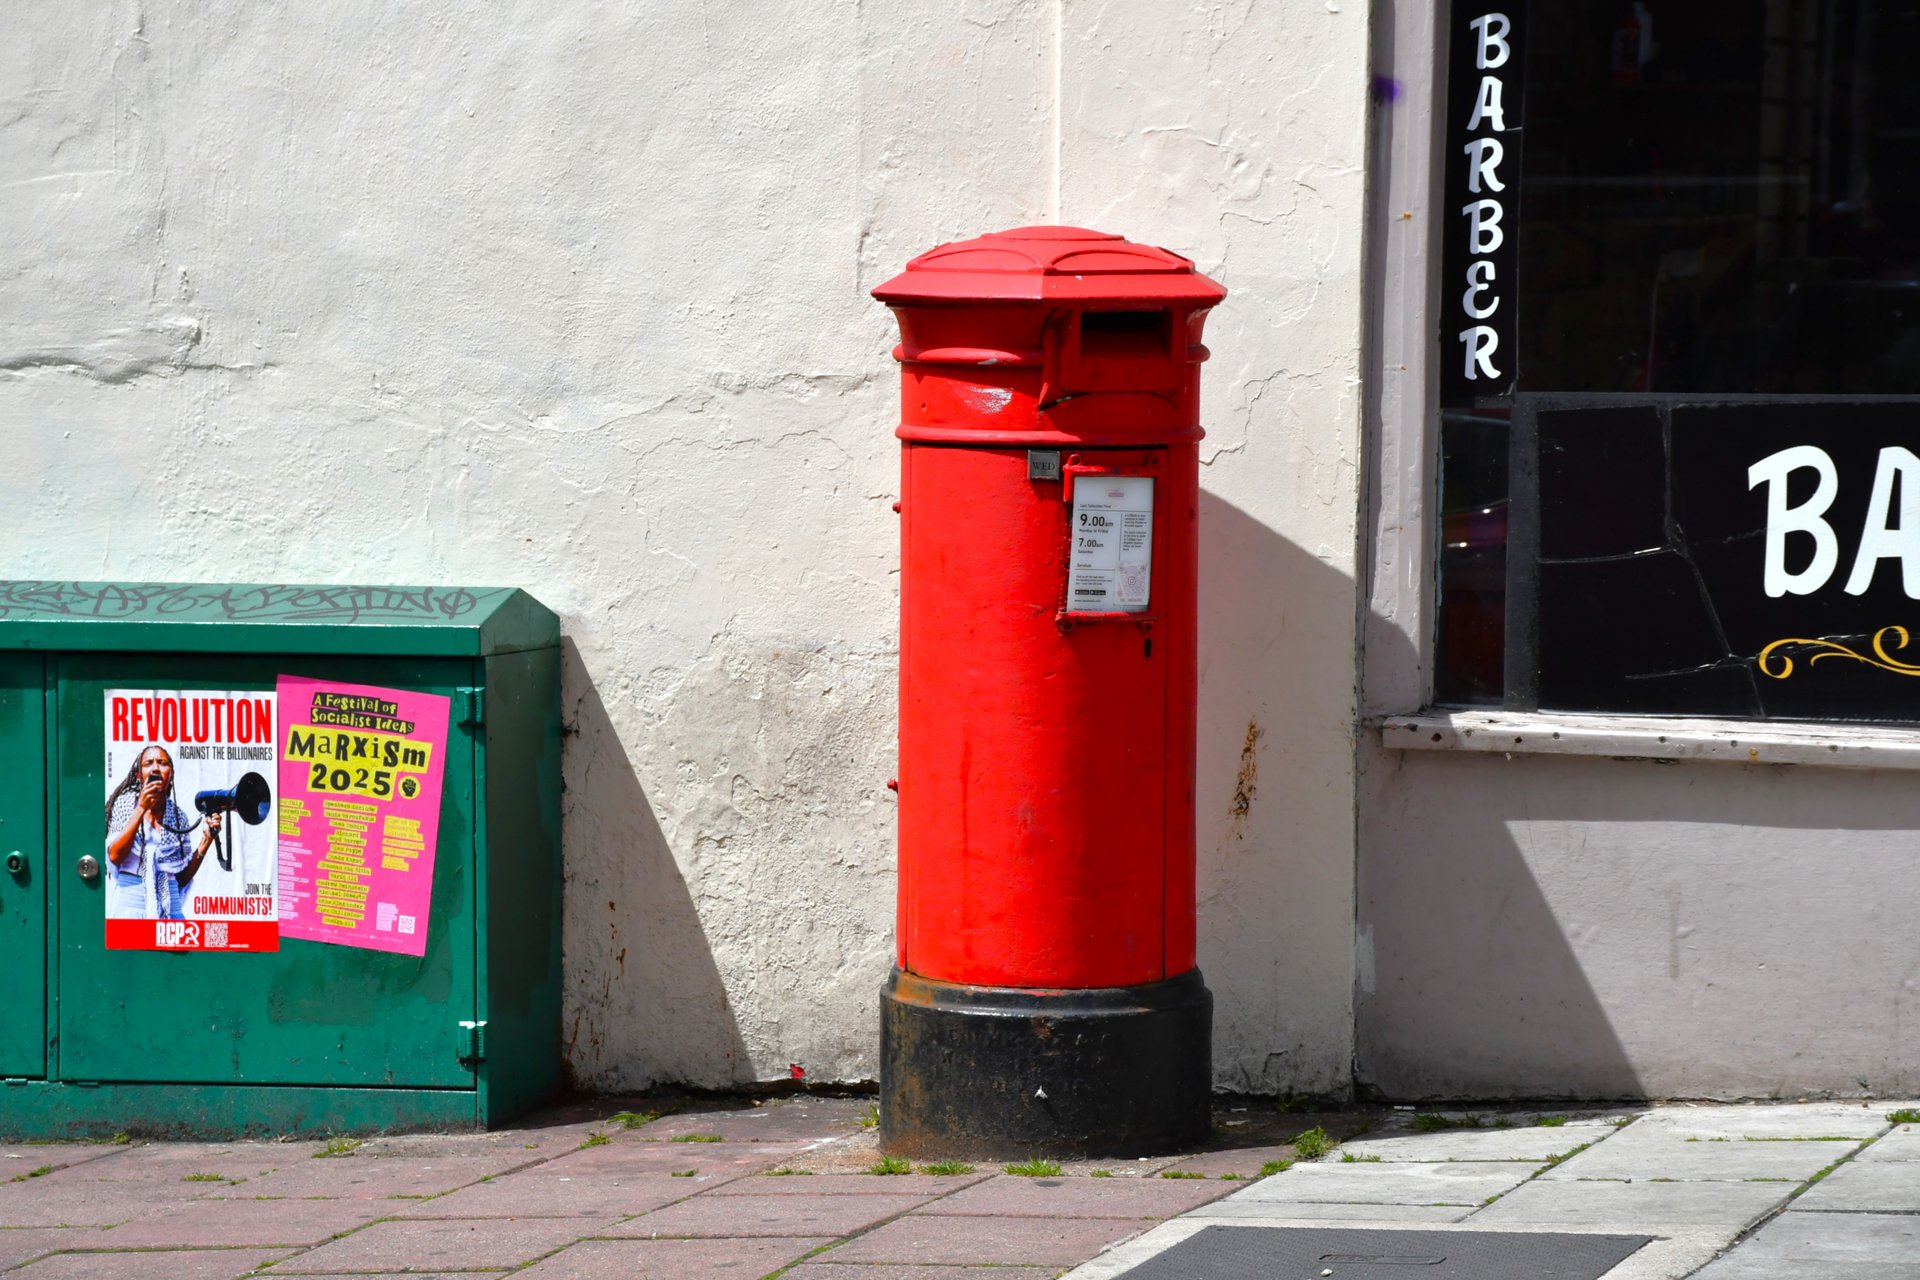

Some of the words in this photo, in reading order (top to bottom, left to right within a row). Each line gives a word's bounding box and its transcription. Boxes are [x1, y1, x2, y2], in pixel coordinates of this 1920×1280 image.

[1459, 12, 1511, 381] BARBER
[1032, 461, 1056, 471] WED
[1080, 513, 1114, 527] 9.00am
[1078, 538, 1104, 548] 7.00am
[314, 694, 322, 706] A
[382, 703, 397, 714] of
[112, 697, 272, 744] REVOLUTION
[179, 745, 210, 760] AGAINST
[213, 746, 225, 760] THE
[227, 746, 273, 761] BILLIONAIRES
[311, 763, 391, 796] 2025
[245, 883, 260, 895] JOIN
[261, 883, 272, 896] THE
[194, 895, 273, 916] COMMUNISTS!
[156, 921, 185, 945] RCP
